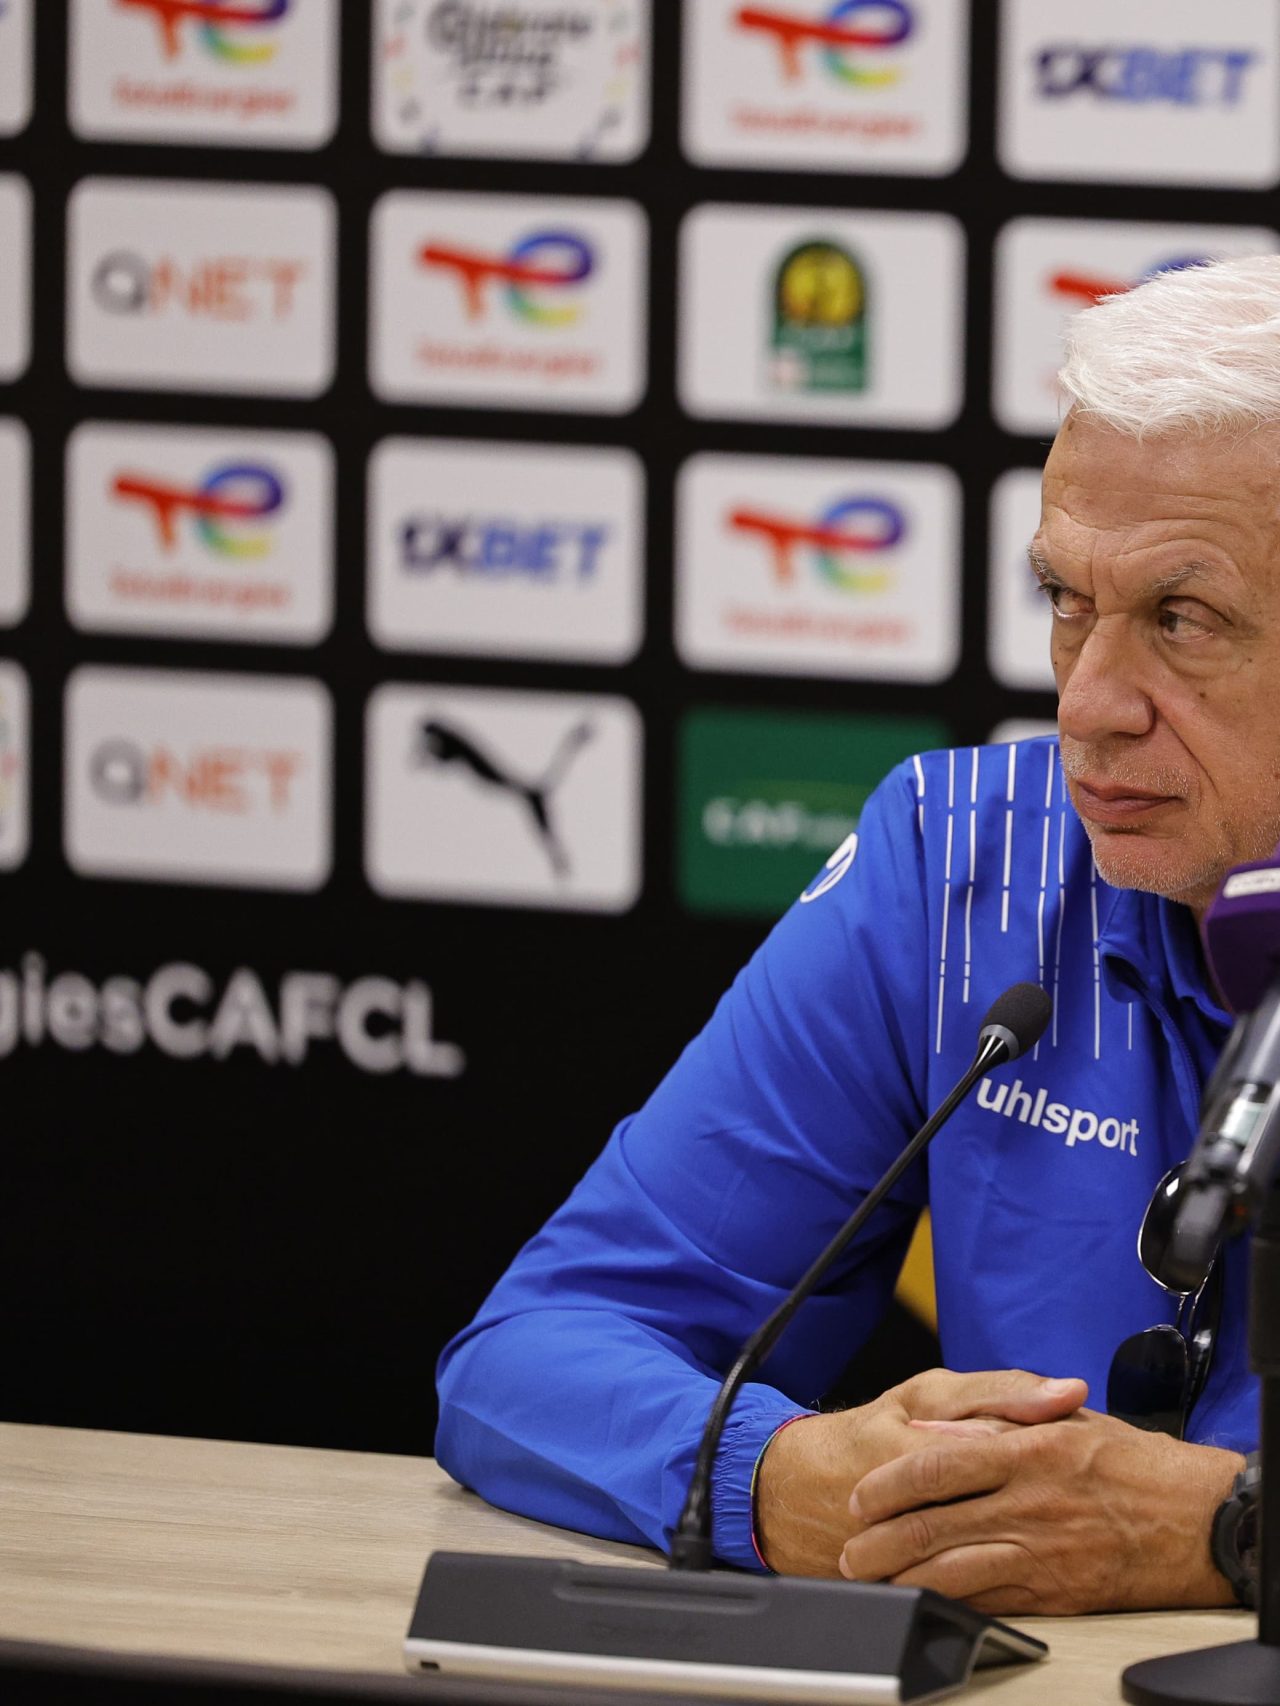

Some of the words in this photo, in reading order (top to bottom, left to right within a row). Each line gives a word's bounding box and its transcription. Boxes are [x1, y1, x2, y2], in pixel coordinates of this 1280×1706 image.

[91, 250, 302, 321] QNET
[88, 739, 298, 812] QNET
[976, 1078, 1140, 1157] uhlsport
